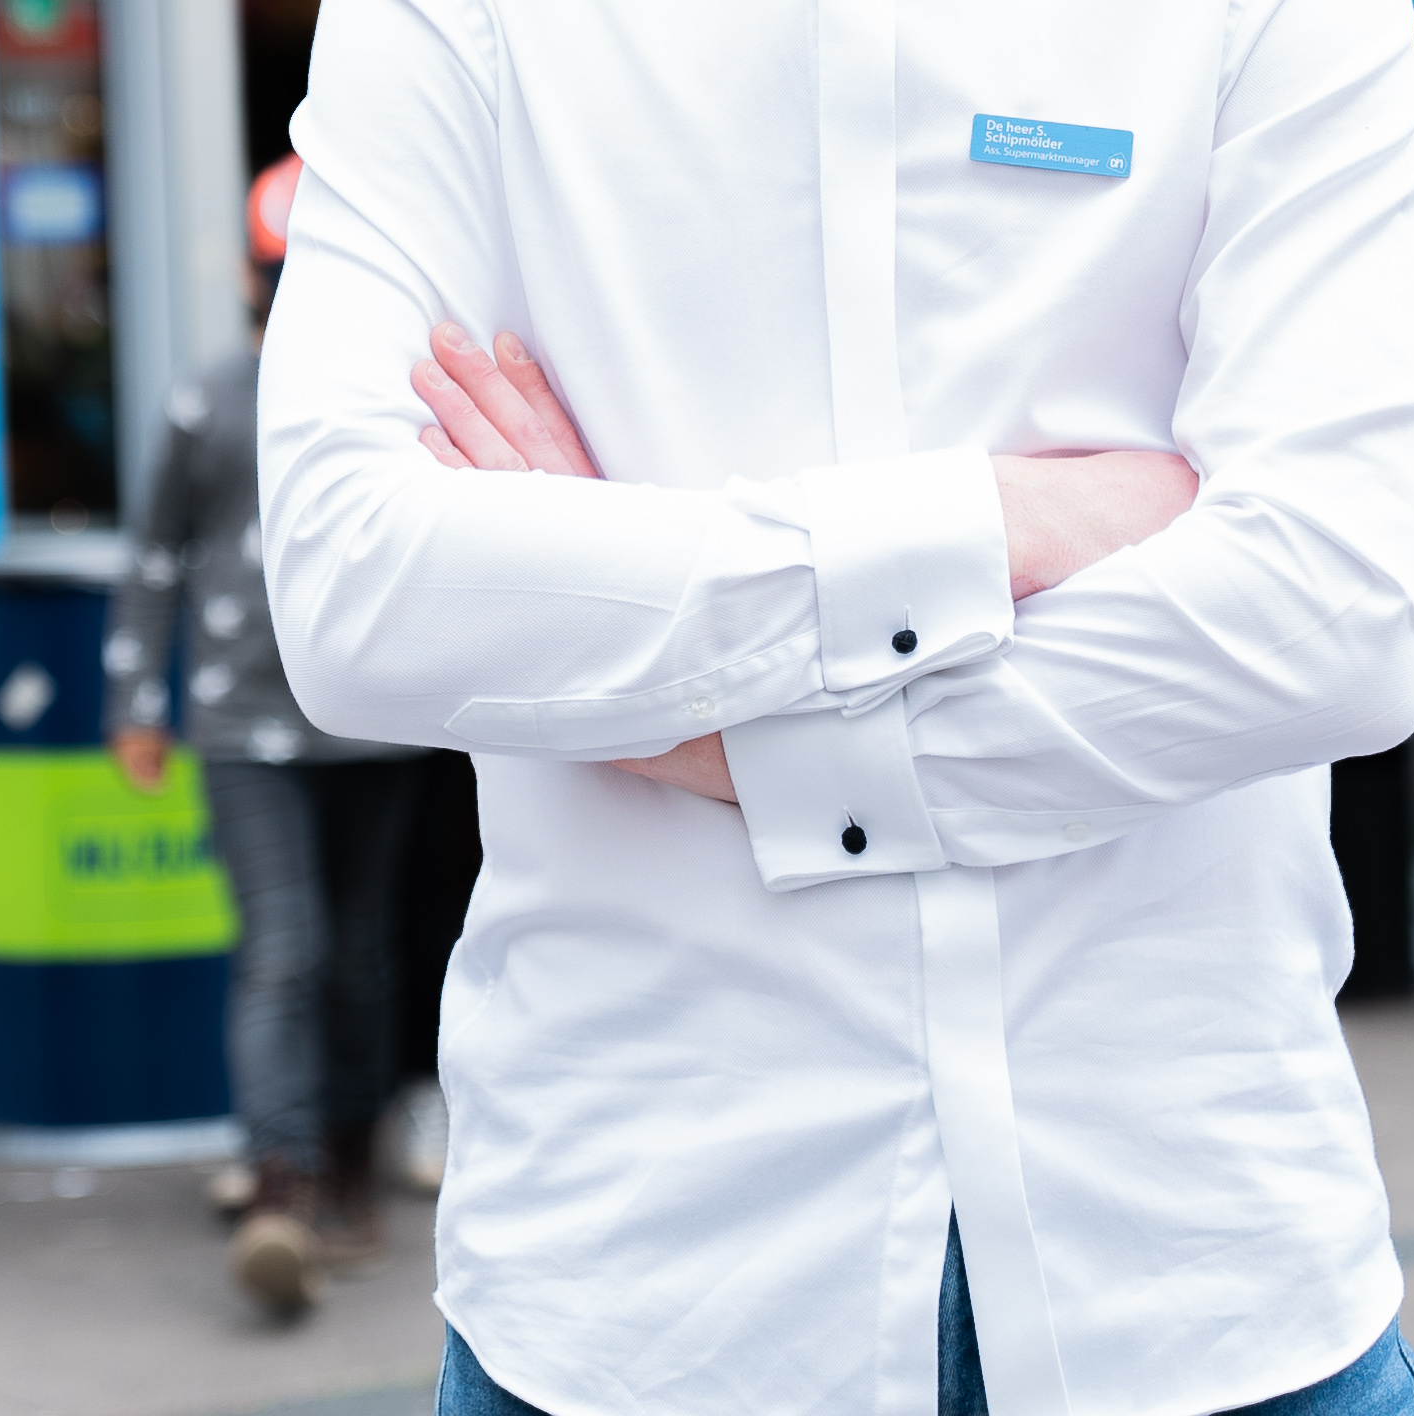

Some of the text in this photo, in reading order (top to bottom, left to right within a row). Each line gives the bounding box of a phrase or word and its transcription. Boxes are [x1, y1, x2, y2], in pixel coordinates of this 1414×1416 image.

[986, 119, 1047, 137] De heer S.
[985, 131, 1063, 150] Schipmölder
[983, 144, 1100, 167] Ass. Supermarktmanager
